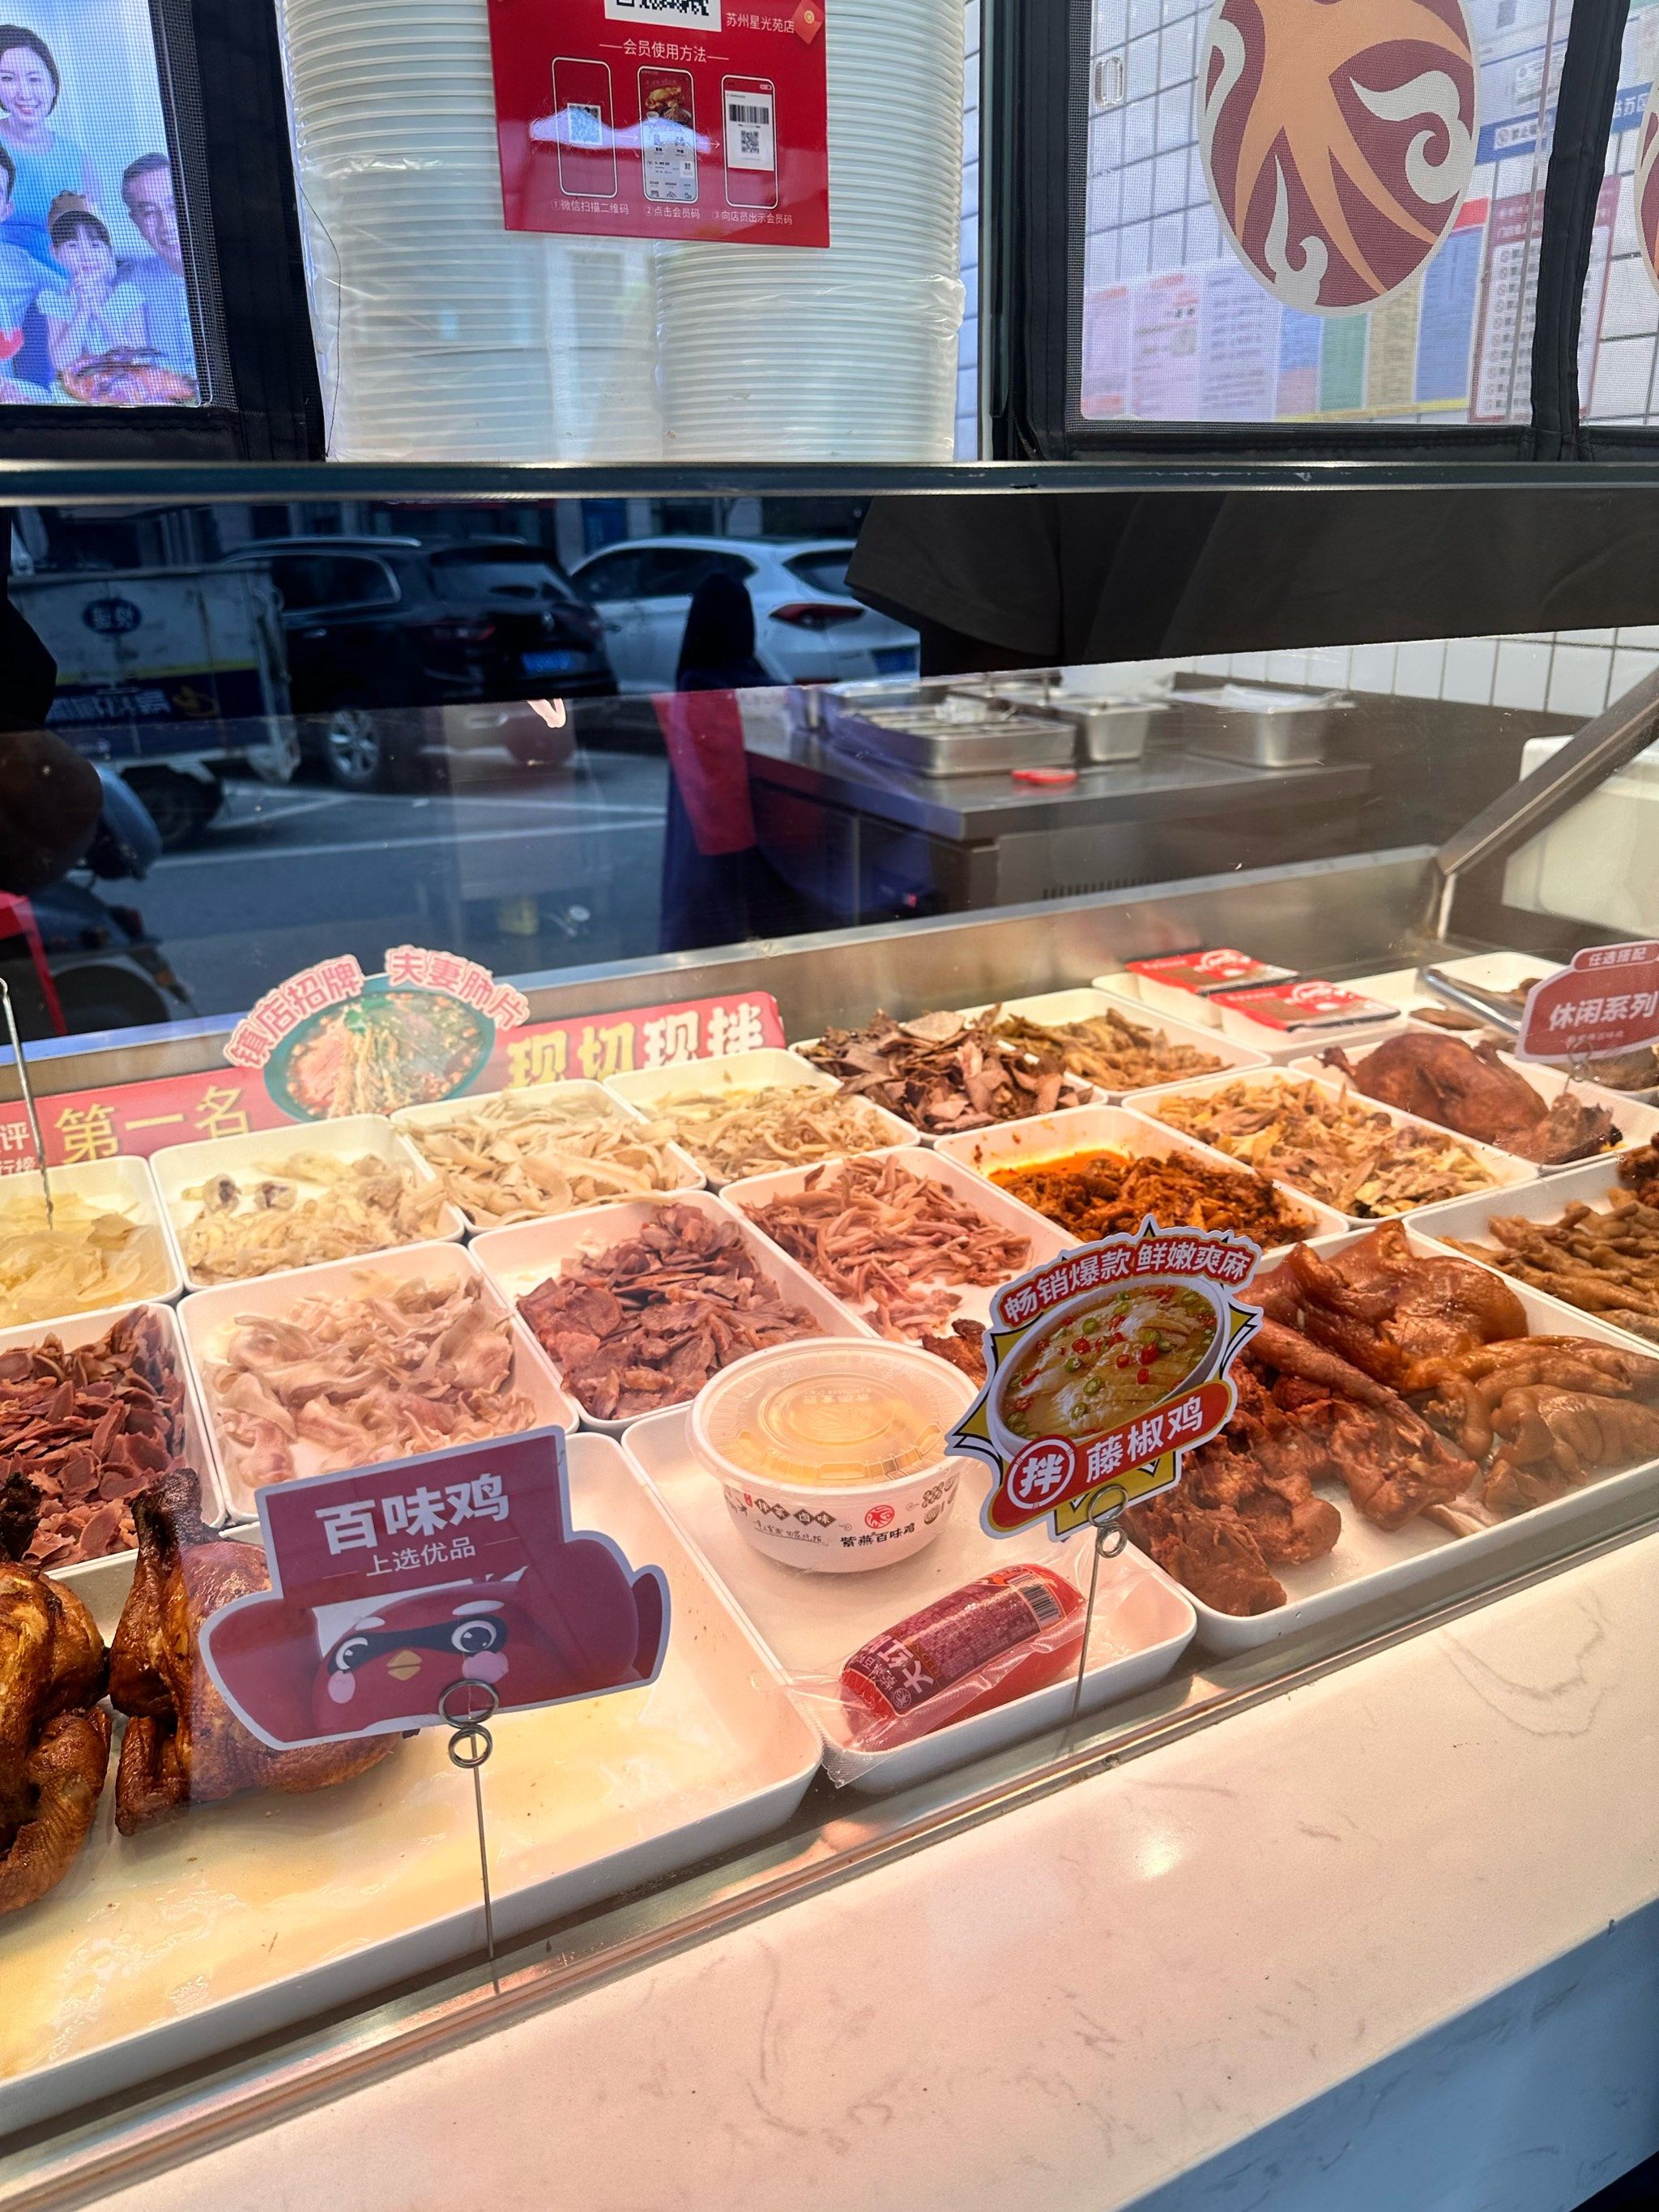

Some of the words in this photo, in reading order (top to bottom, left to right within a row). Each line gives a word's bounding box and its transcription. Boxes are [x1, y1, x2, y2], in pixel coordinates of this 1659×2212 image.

[623, 38, 707, 63] 会员使用方法
[726, 12, 795, 34] 苏州星光苑店
[1589, 946, 1648, 967] 任选搭配
[232, 959, 362, 1066] 镇店招牌
[390, 951, 527, 1027] 夫妻肺片
[1549, 990, 1659, 1032] 休闲系列
[54, 1086, 249, 1164] 第一名
[1004, 1248, 1131, 1322] 畅销爆款
[1136, 1241, 1252, 1282] 鲜嫩爽麻
[1018, 1454, 1065, 1498] 拌
[1086, 1396, 1203, 1483] 藤椒鸡
[316, 1472, 510, 1556] 百味鸡
[366, 1536, 476, 1577] 上选优品
